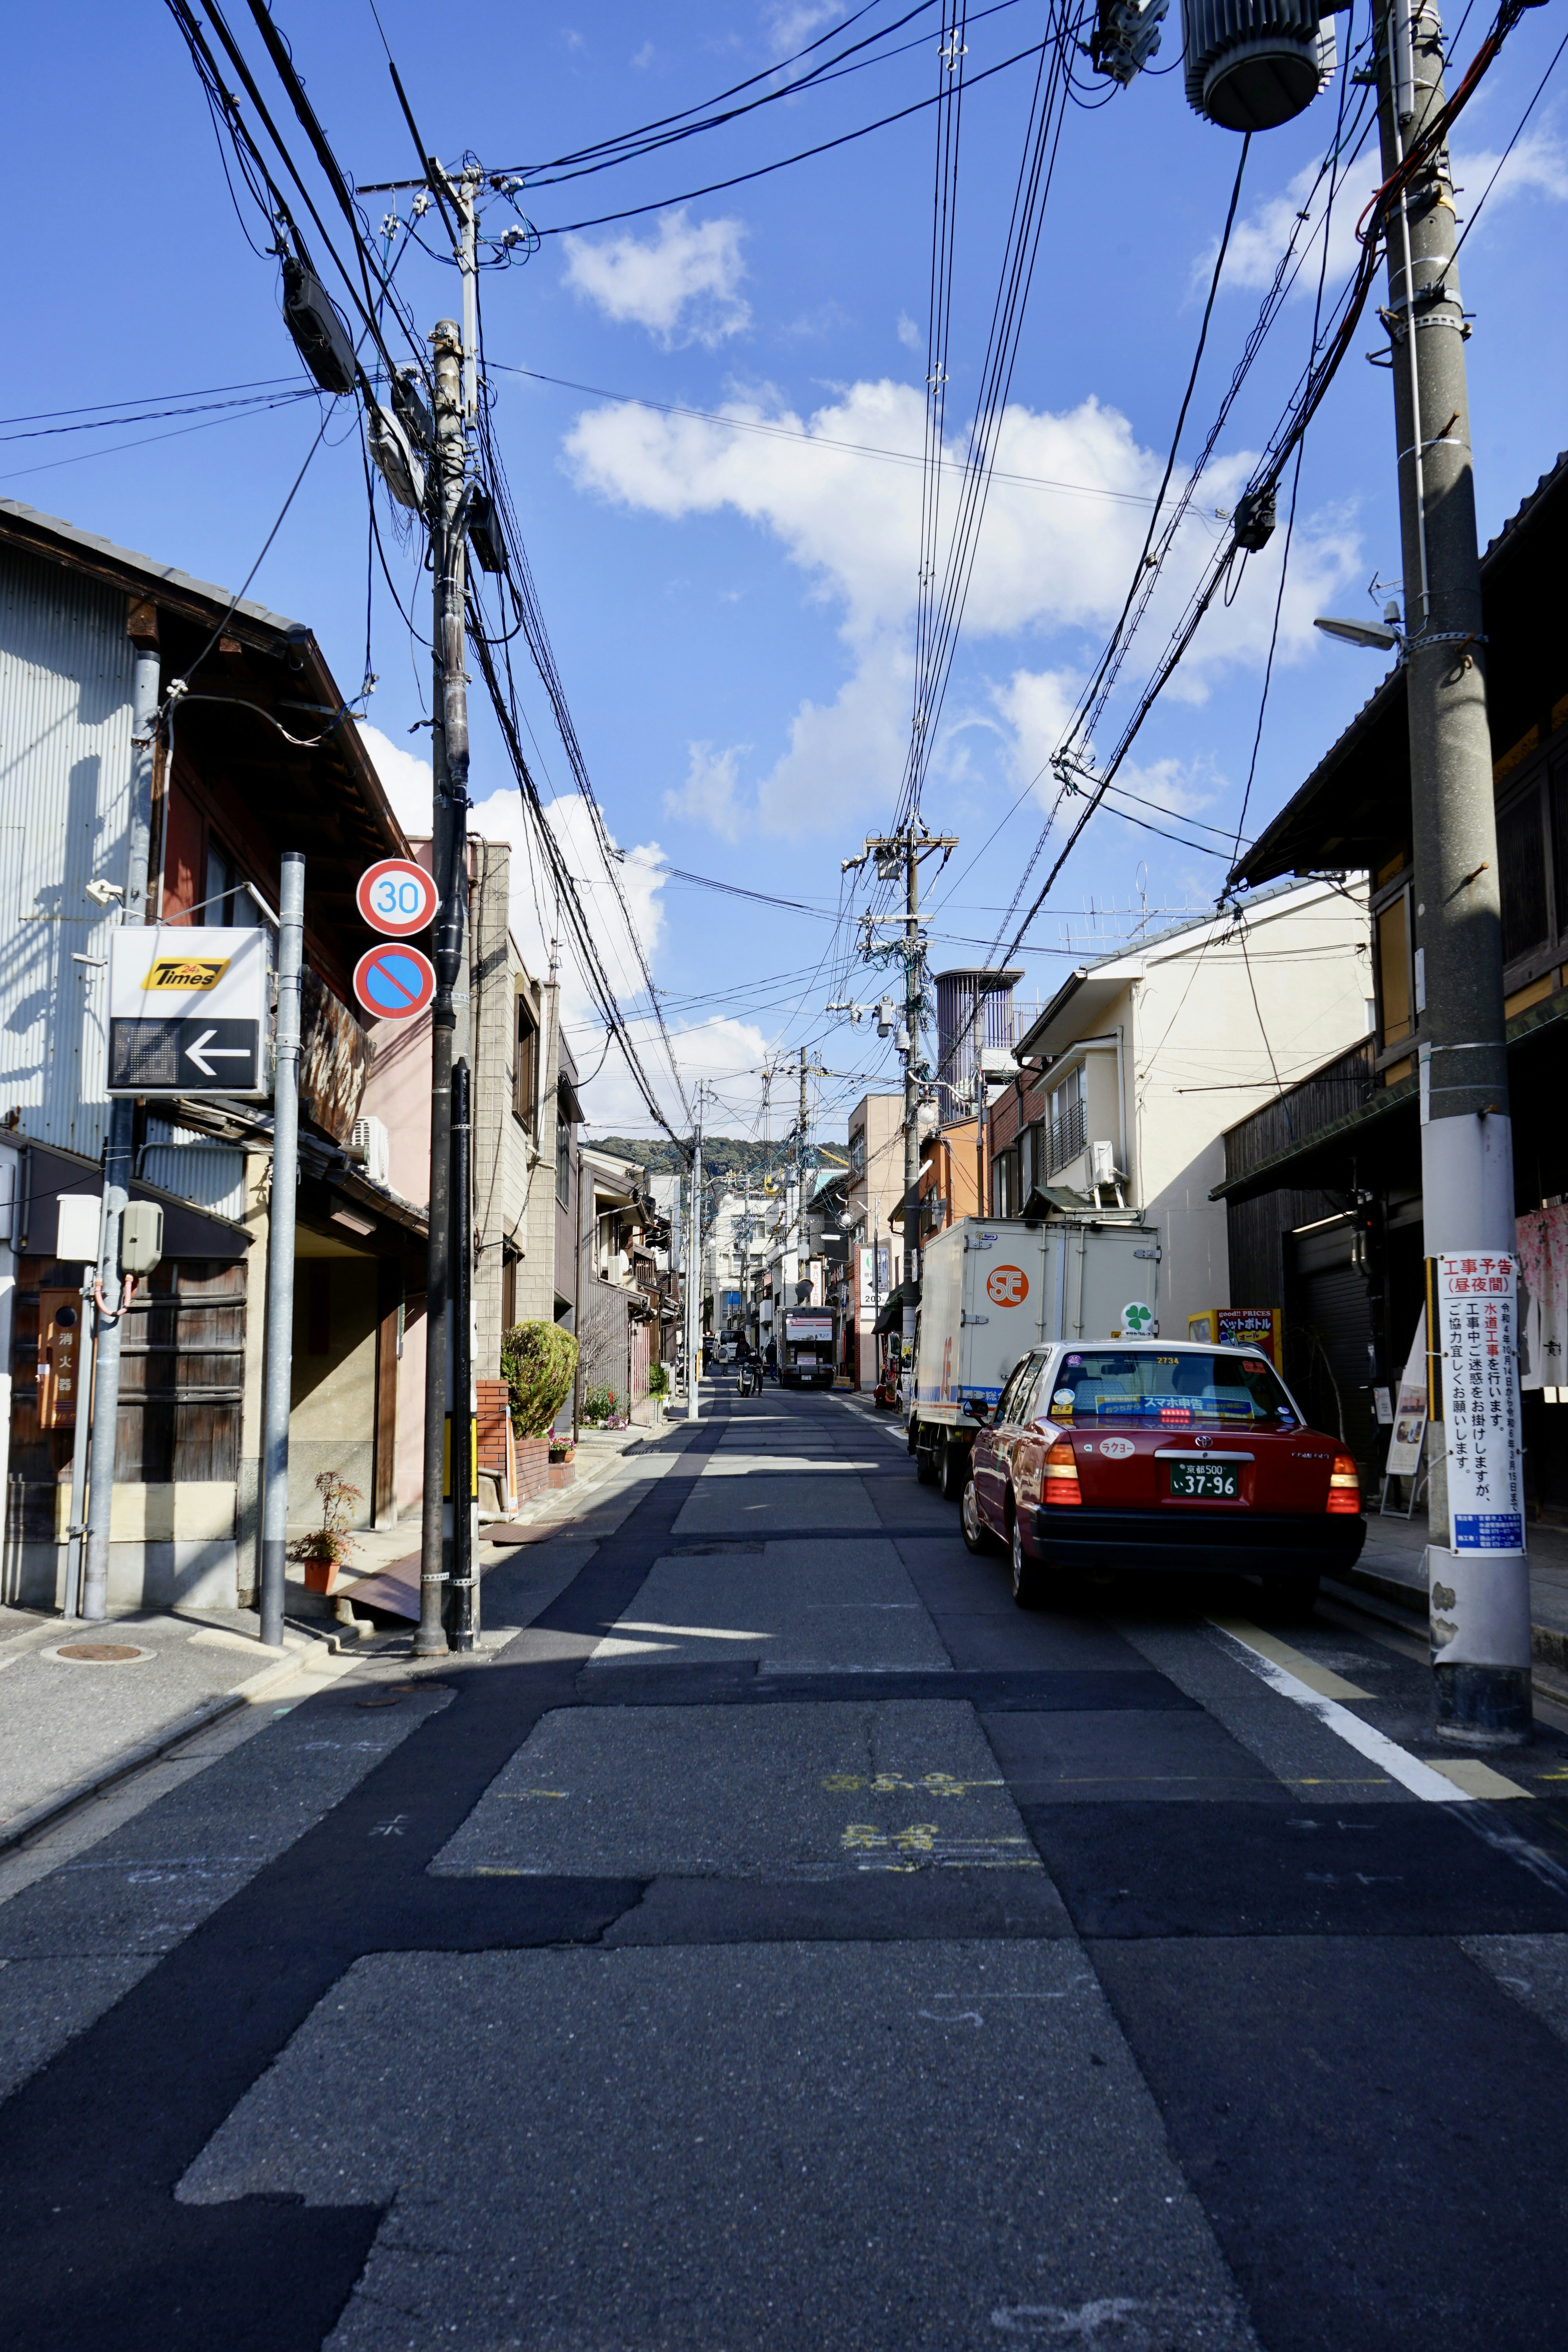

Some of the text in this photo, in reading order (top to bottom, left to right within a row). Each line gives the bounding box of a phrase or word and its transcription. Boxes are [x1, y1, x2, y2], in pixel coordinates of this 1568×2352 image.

[377, 881, 418, 913] 30
[156, 970, 215, 985] Times
[1443, 1258, 1513, 1275] 工事予告
[1220, 1317, 1271, 1330] ペットボトル
[1239, 1332, 1259, 1341] オール
[59, 1333, 73, 1391] 消火器
[1484, 1302, 1504, 1431] 水道工事を行います。
[1449, 1303, 1470, 1474] ご協力宜しくお願いします。
[1105, 1403, 1141, 1414] おうちから
[1145, 1397, 1203, 1410] スマホ申告
[1466, 1303, 1490, 1502] 工事中ご迷惑をお掛けしますが、
[1102, 1442, 1133, 1453] ラクヨー
[1185, 1475, 1234, 1494] 37-96
